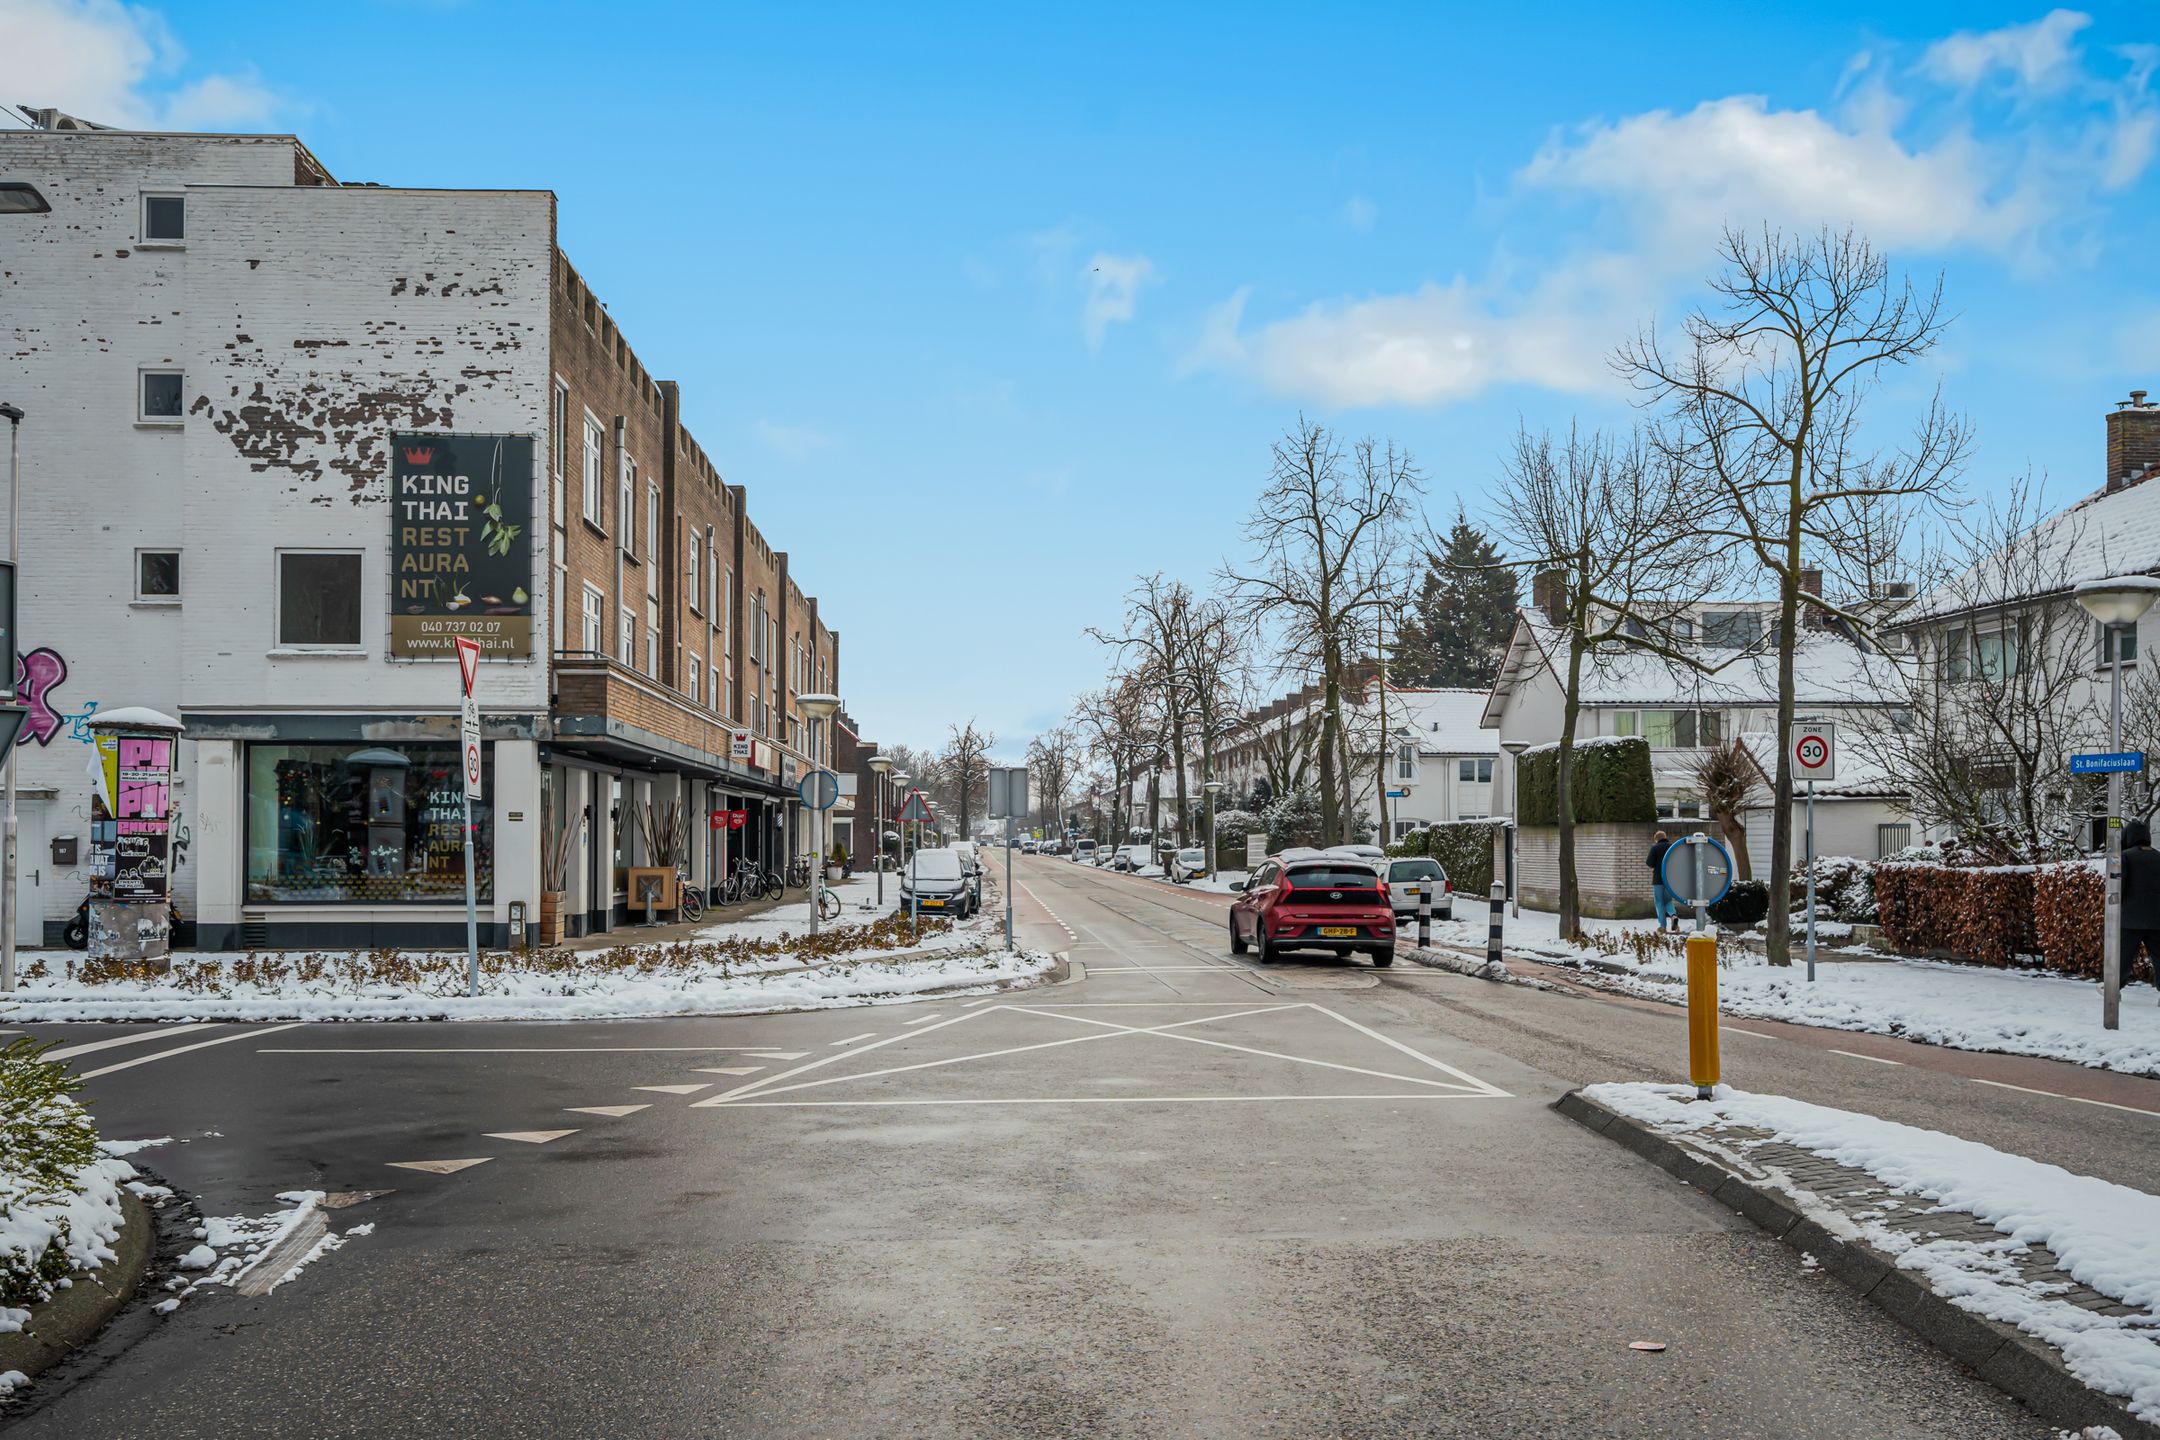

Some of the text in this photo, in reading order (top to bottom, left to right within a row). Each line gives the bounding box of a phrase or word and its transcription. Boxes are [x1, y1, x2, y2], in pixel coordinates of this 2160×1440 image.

[402, 475, 469, 494] KING
[402, 501, 469, 520] THAI
[402, 527, 470, 546] REST
[401, 553, 469, 572] AURA
[401, 579, 433, 598] NT
[421, 621, 501, 633] 040 737 02 07
[1803, 746, 1822, 757] 30
[2075, 758, 2136, 768] St. Bonifaciuslaan
